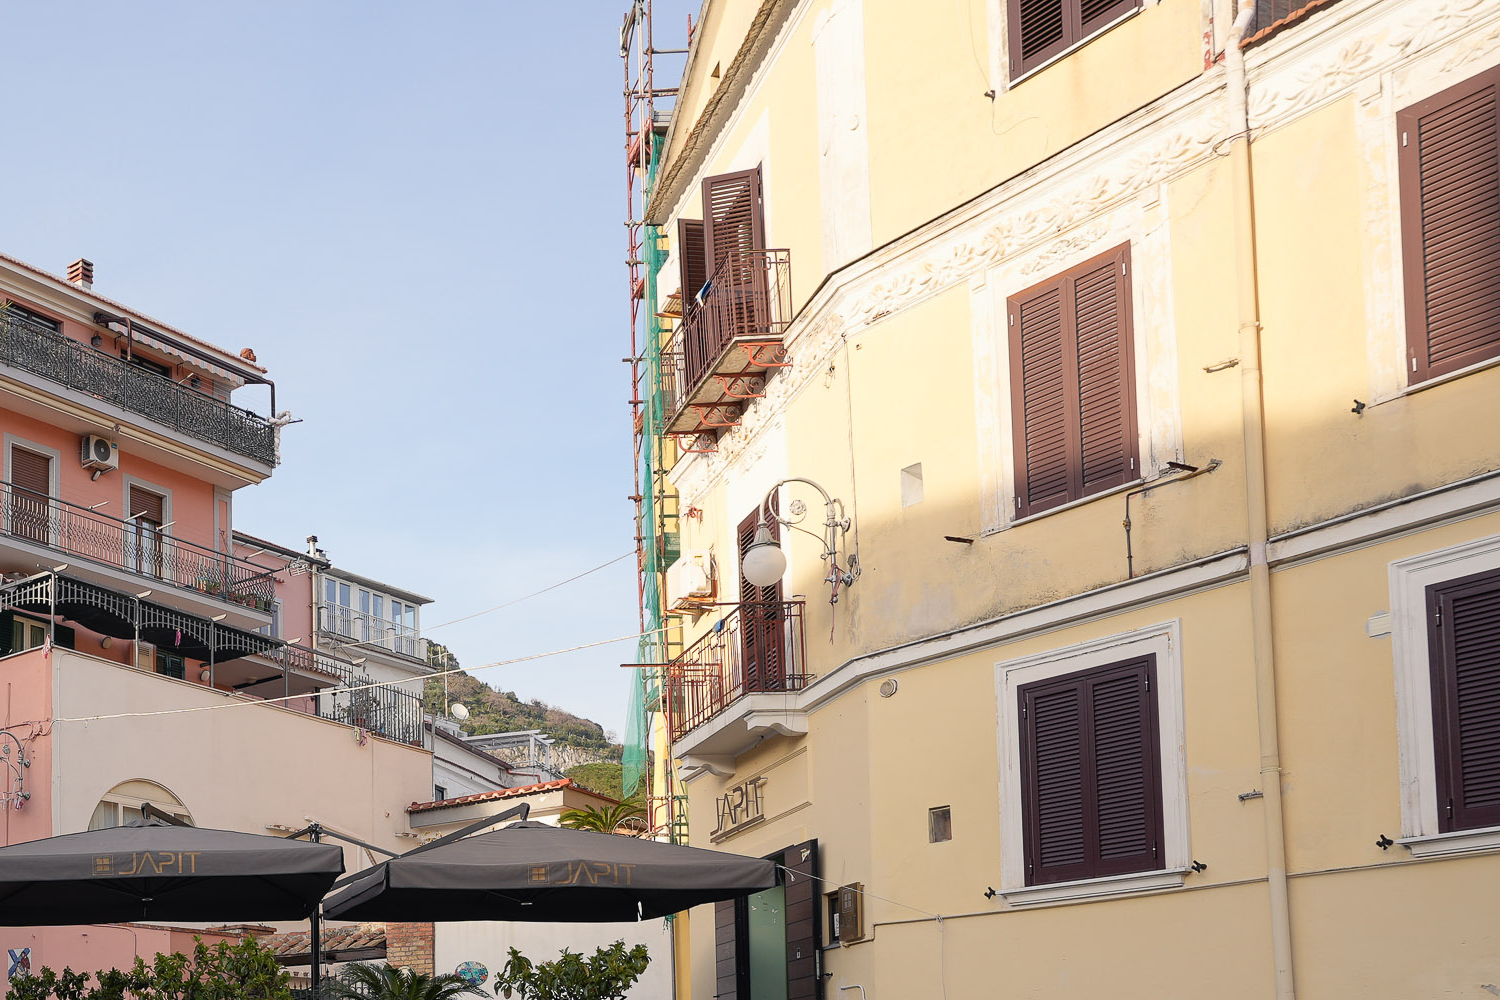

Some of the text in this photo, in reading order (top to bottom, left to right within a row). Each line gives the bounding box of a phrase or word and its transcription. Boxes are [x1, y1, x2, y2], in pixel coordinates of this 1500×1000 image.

[710, 776, 763, 836] JAPIT
[118, 851, 202, 875] JAPIT
[555, 862, 637, 885] JAPIT
